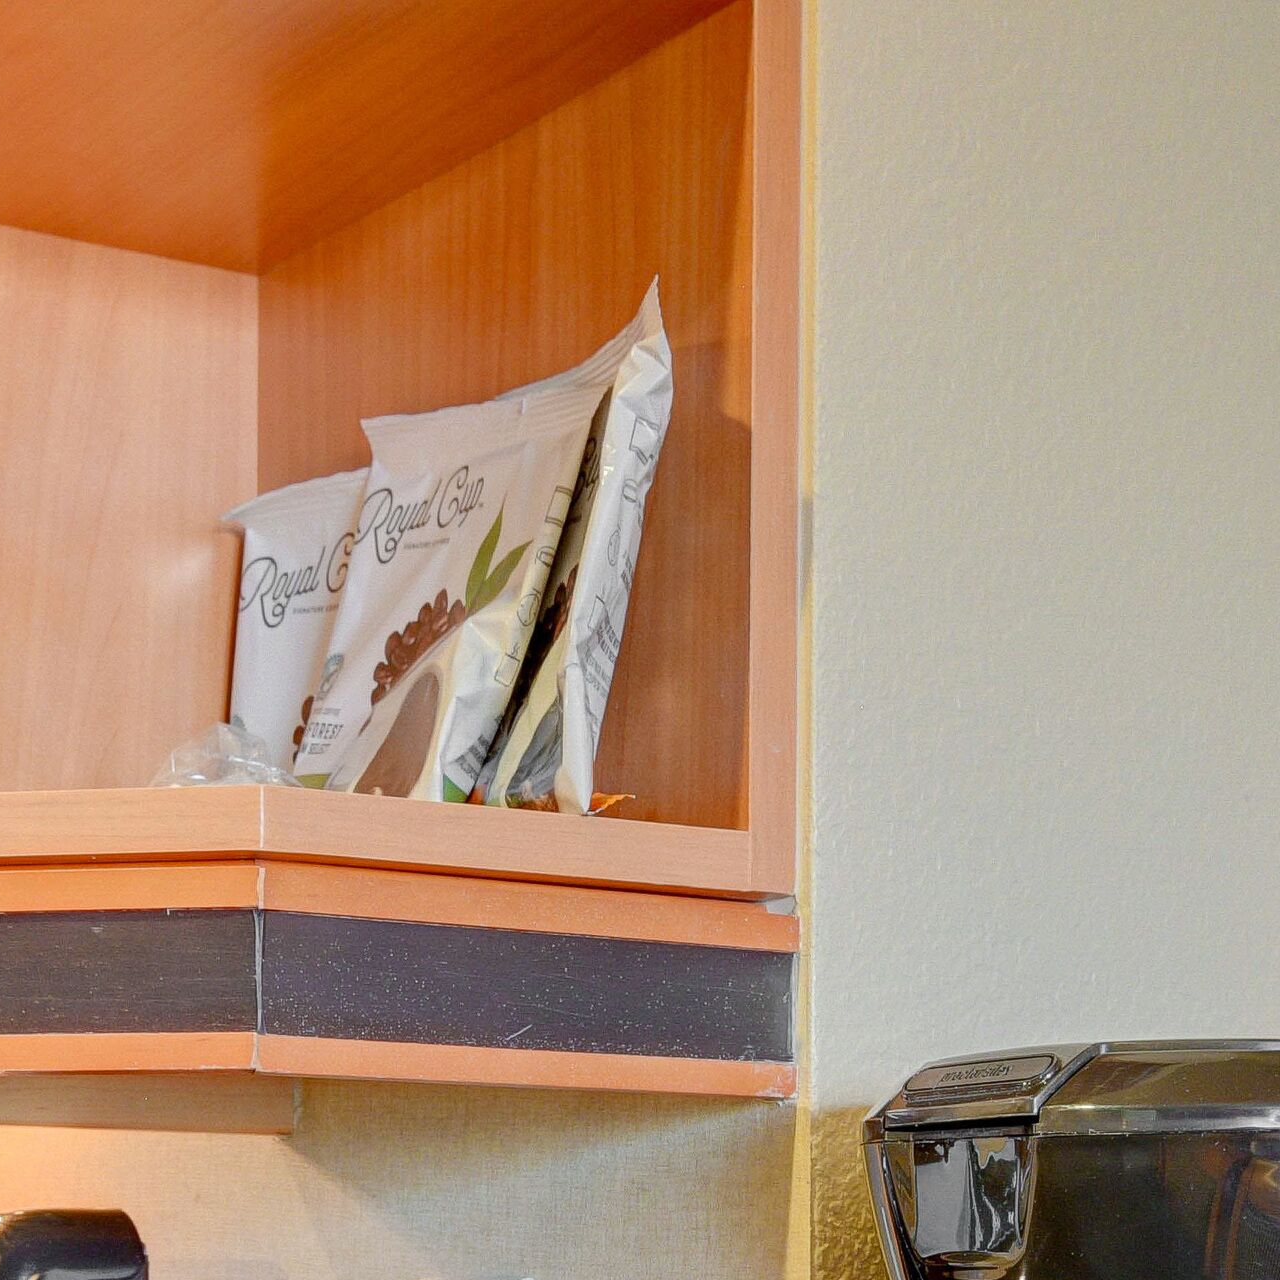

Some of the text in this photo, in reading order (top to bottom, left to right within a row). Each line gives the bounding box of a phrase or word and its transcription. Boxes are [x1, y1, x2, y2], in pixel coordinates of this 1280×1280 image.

[353, 478, 442, 564] Royal
[437, 465, 484, 528] Cup
[240, 545, 326, 628] Royal
